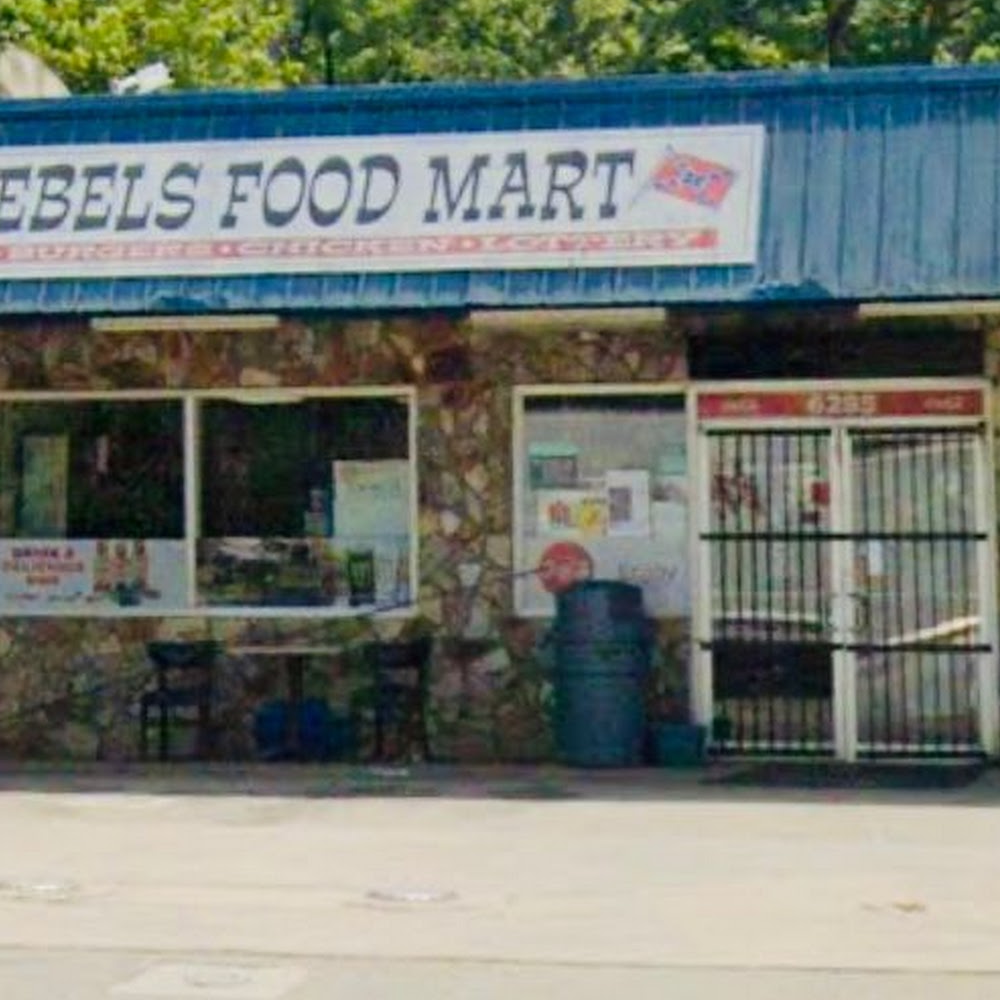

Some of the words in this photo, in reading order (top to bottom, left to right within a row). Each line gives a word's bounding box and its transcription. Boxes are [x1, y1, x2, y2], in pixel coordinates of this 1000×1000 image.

[219, 154, 401, 229] FOOD
[422, 149, 637, 224] MART
[237, 236, 450, 257] CHICKEN
